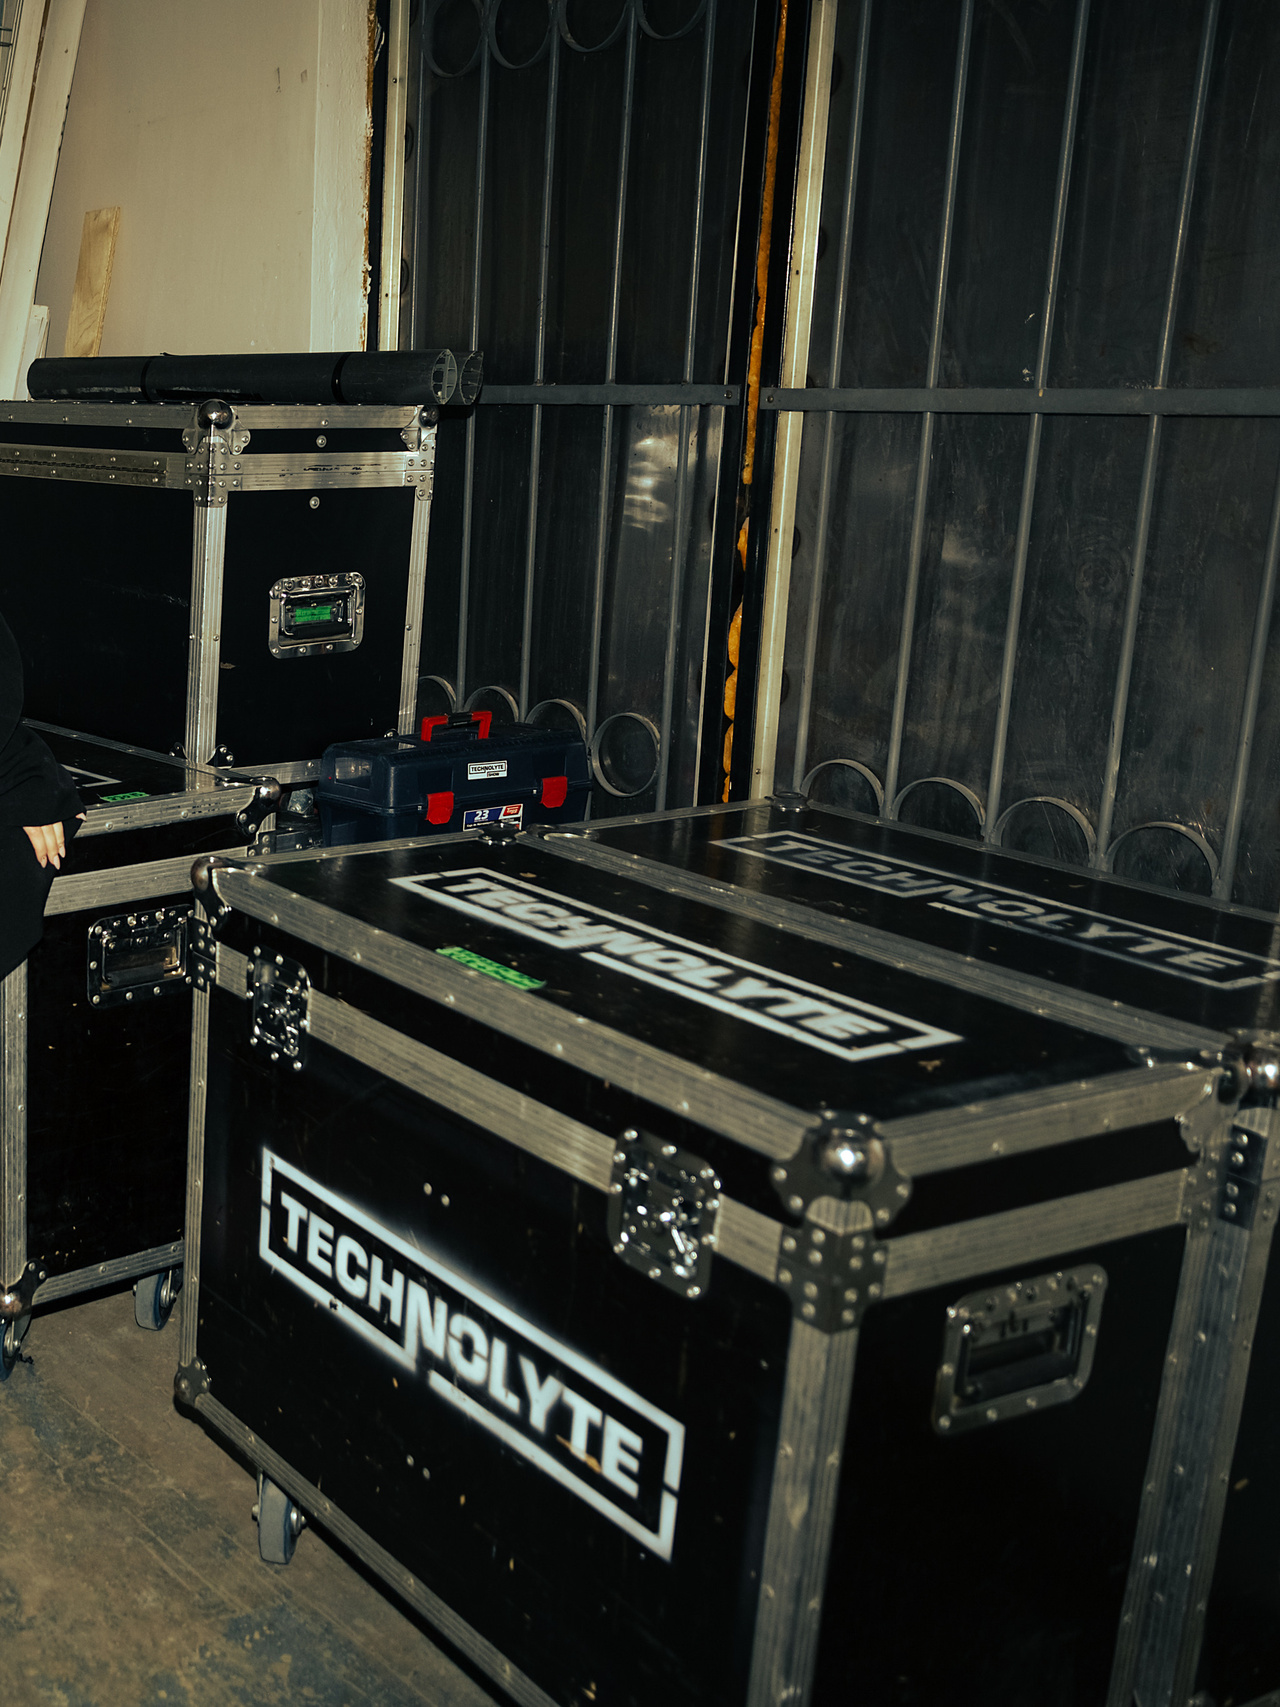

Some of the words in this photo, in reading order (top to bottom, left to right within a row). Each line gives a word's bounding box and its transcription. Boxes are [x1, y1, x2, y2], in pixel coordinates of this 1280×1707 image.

[474, 809, 489, 820] 23
[443, 878, 891, 1041] TECHNOLYTE
[765, 839, 1245, 973] TECHNOLYTE
[280, 1191, 643, 1499] TECHNOLYTE
